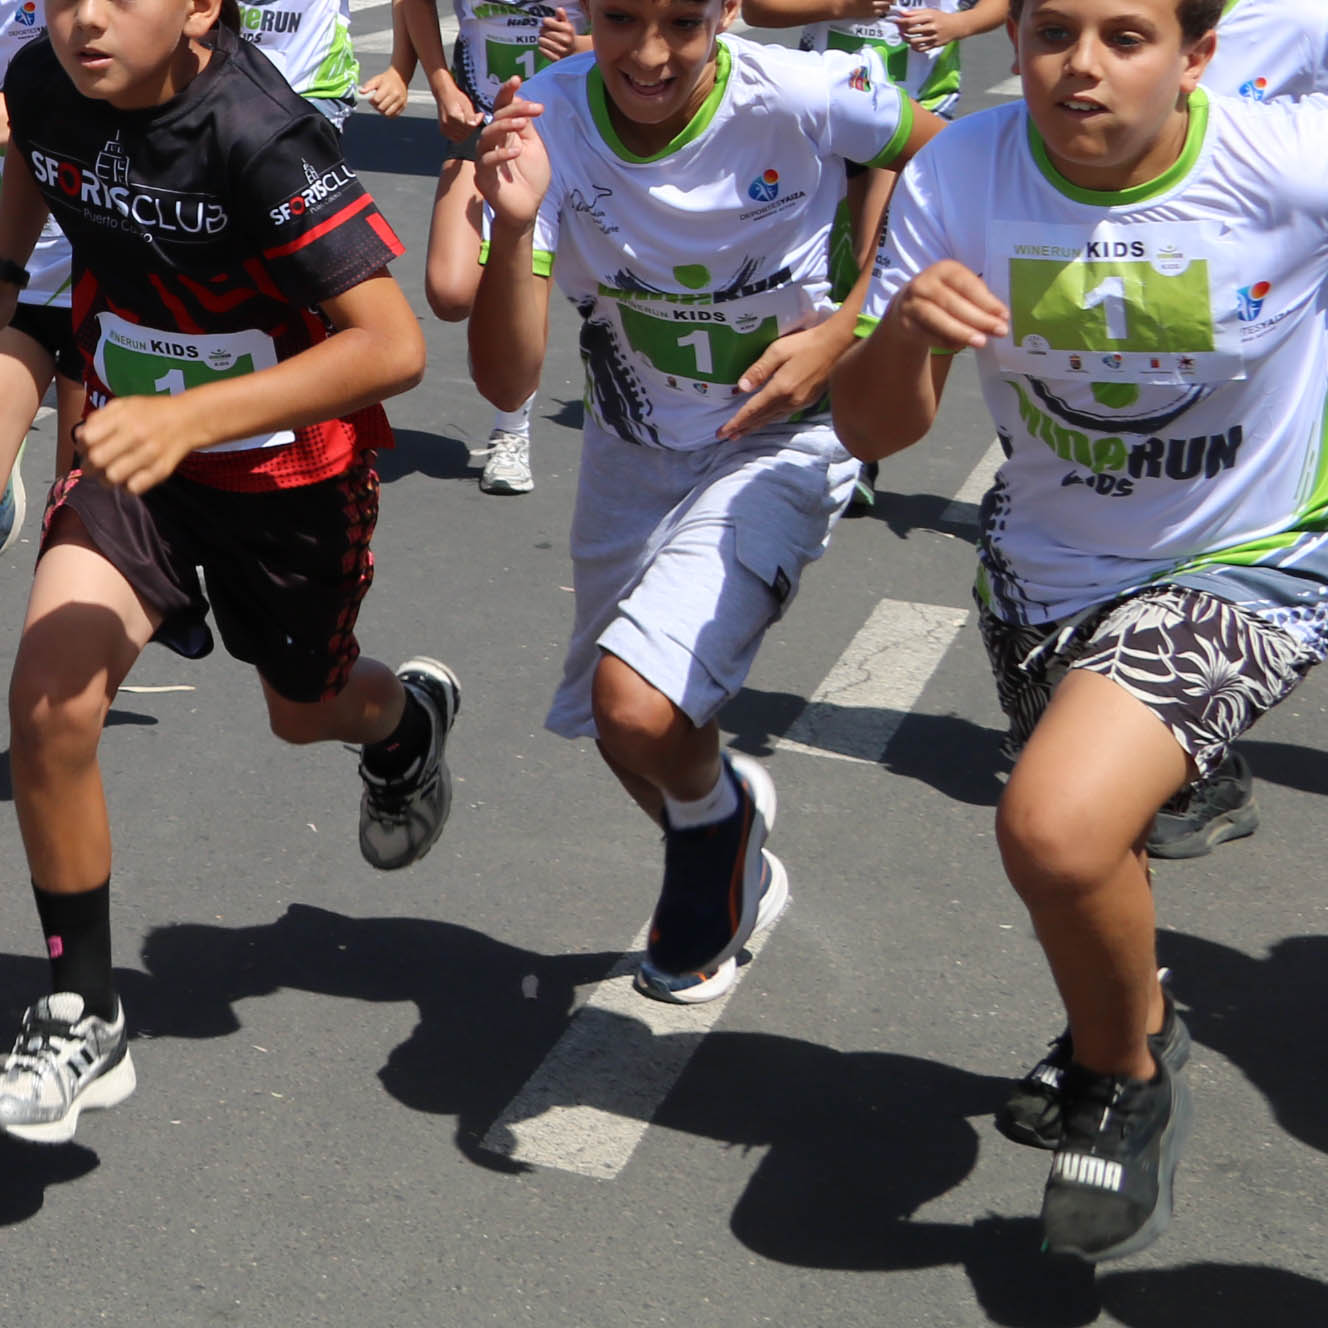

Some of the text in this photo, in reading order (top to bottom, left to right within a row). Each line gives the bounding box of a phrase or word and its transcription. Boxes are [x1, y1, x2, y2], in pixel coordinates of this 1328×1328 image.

[516, 35, 537, 44] KID
[515, 50, 536, 79] 1
[1013, 241, 1145, 258] WINERUN KIDS
[672, 310, 727, 322] KIDS
[1083, 276, 1128, 339] 1
[151, 339, 199, 358] KIDS
[677, 330, 713, 374] 1
